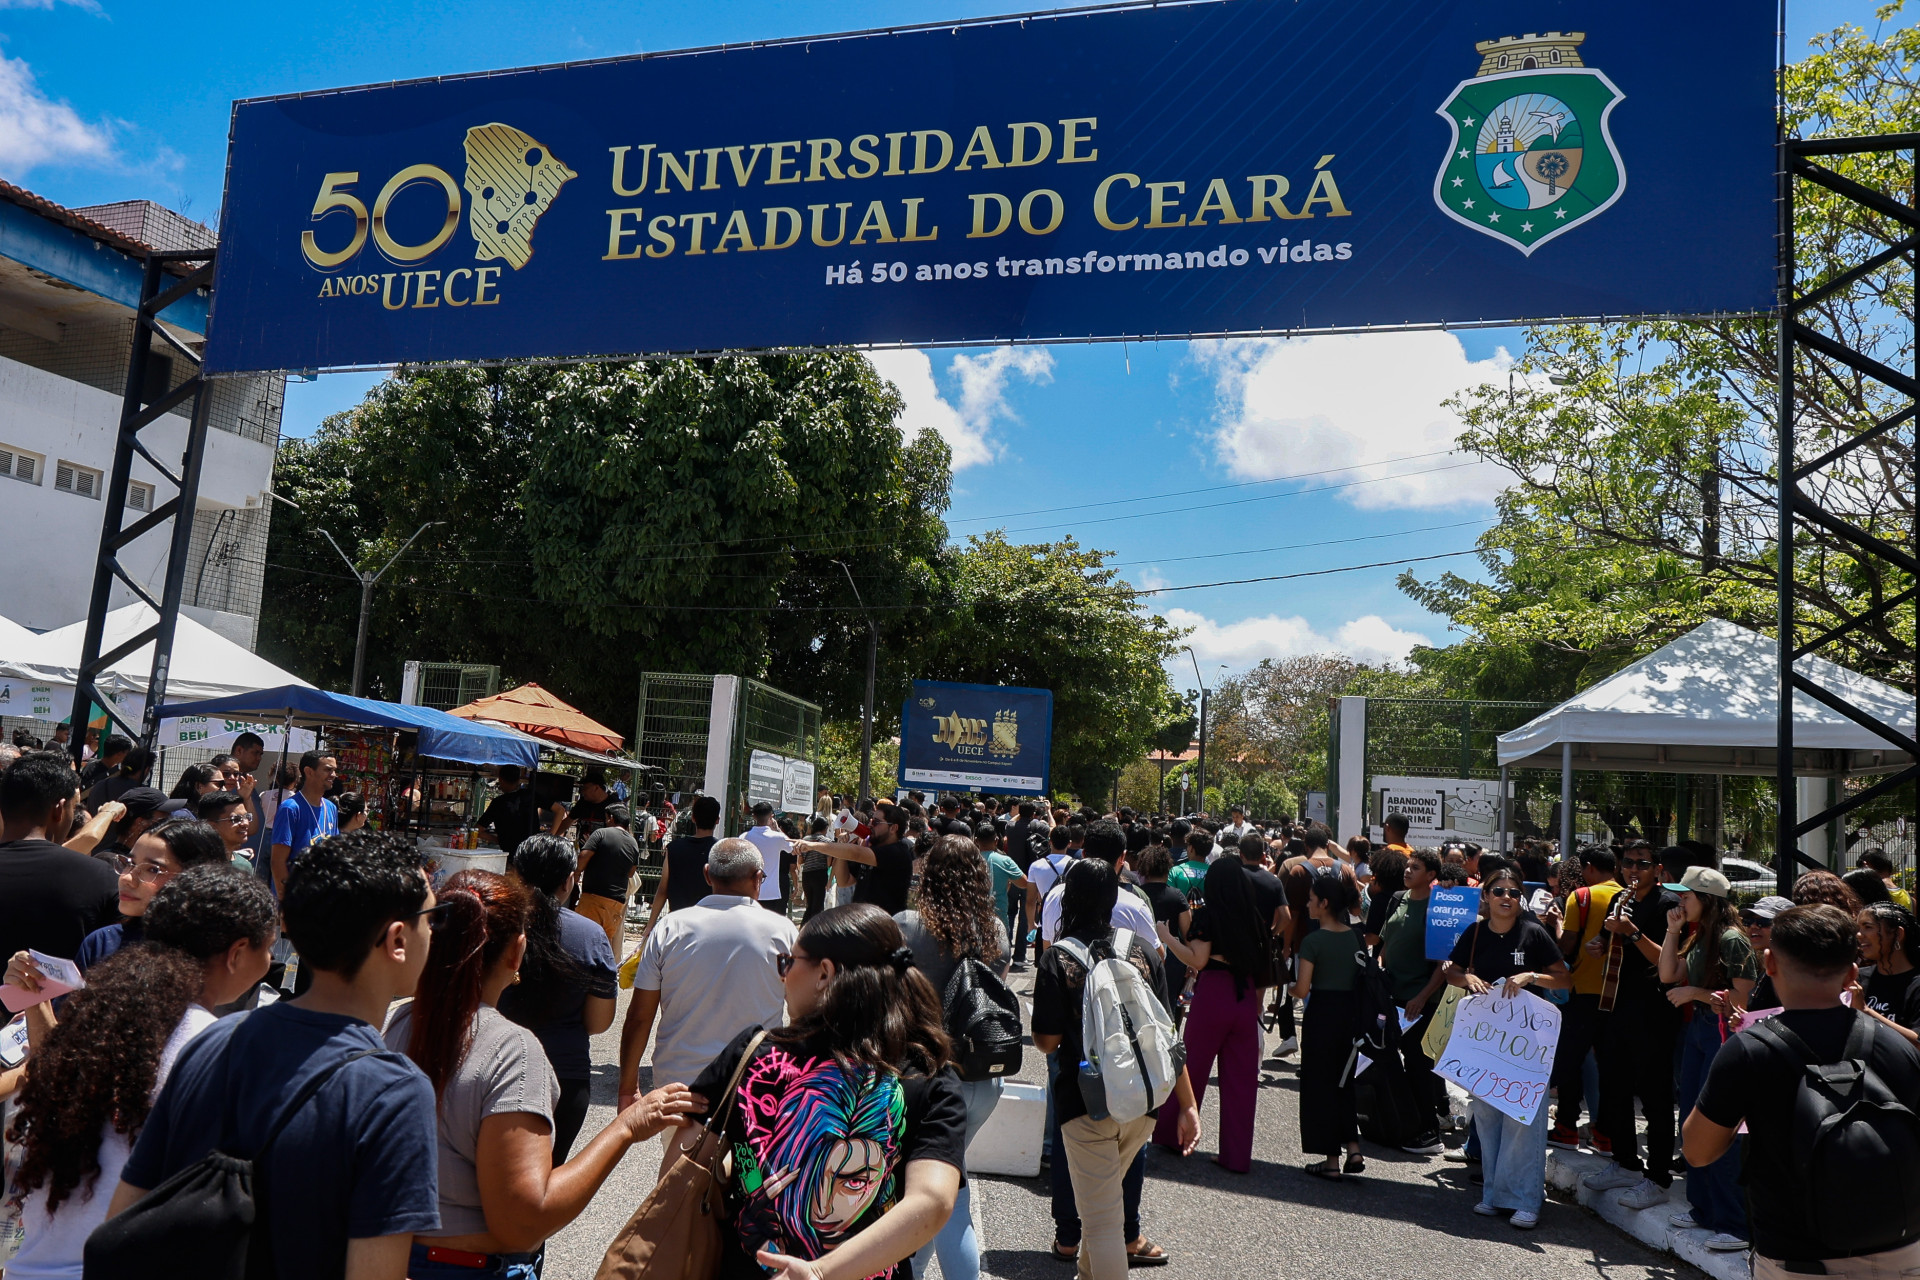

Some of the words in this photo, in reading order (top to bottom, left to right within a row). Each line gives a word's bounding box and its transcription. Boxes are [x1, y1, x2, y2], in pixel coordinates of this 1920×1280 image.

[609, 117, 1098, 197] UNIVERSIDADE
[602, 198, 938, 261] ESTADUAL
[966, 189, 1064, 239] DO
[1094, 155, 1352, 231] CEARÁ
[301, 164, 461, 268] 50
[826, 260, 864, 285] Há
[871, 261, 908, 283] 50
[915, 262, 989, 281] anos
[996, 244, 1250, 277] transformando
[1258, 238, 1353, 264] vidas
[318, 275, 379, 298] ANOS
[381, 267, 501, 310] UECE
[180, 731, 208, 742] BEM
[957, 745, 984, 756] UECE
[1387, 796, 1437, 806] ABANDONO
[1401, 806, 1436, 815] ANIMAL
[1407, 815, 1432, 824] RIME
[1435, 892, 1464, 902] Posso
[1433, 905, 1451, 914] orar
[1452, 907, 1468, 917] por
[1431, 918, 1459, 928] você?
